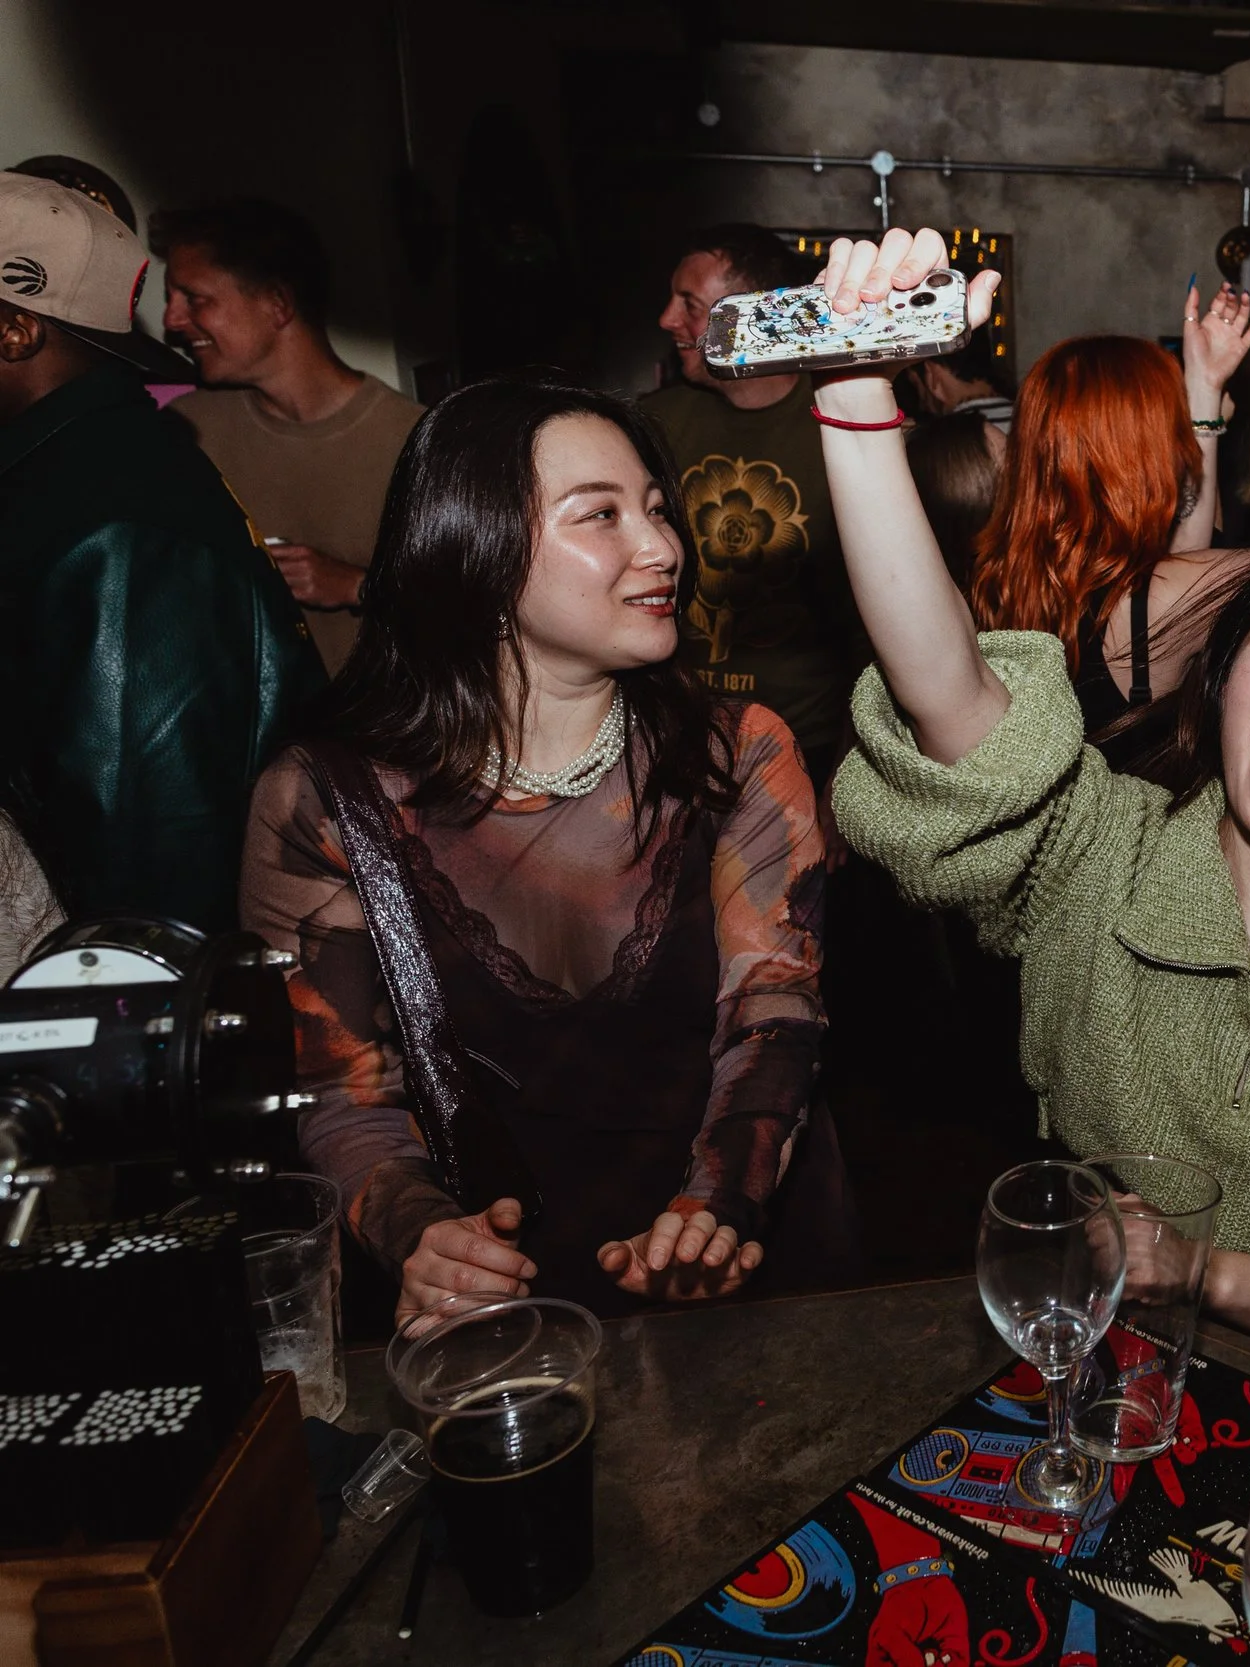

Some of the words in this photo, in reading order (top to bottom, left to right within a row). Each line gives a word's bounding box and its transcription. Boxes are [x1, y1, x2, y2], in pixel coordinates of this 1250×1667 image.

[723, 673, 755, 691] 1871
[856, 1482, 874, 1497] facts
[873, 1492, 886, 1504] the
[885, 1499, 897, 1510] for
[896, 1505, 989, 1560] drinkaware.co.uk
